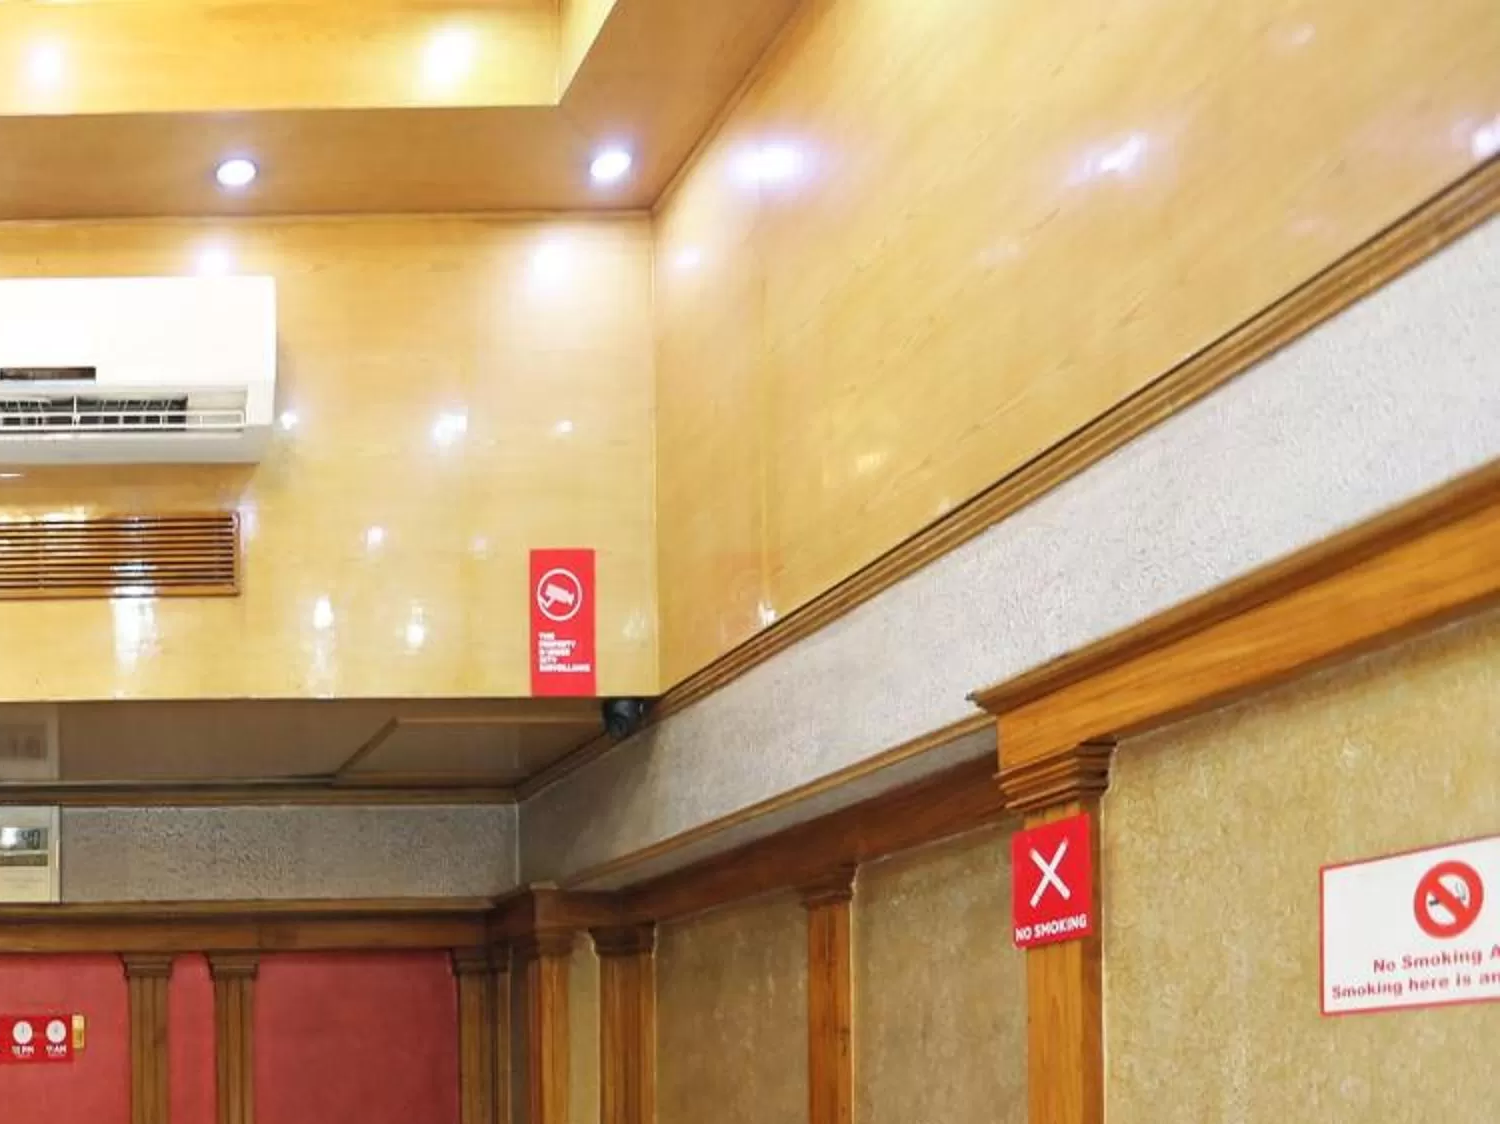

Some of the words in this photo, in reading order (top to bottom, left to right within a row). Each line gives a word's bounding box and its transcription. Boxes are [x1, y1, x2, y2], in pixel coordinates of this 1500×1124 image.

[1015, 926, 1033, 942] NO
[1034, 913, 1088, 938] SMOKING
[1373, 959, 1396, 974] No
[1401, 950, 1483, 970] Smoking
[1332, 980, 1403, 999] Smoking
[1408, 977, 1449, 992] here
[1456, 972, 1471, 986] is
